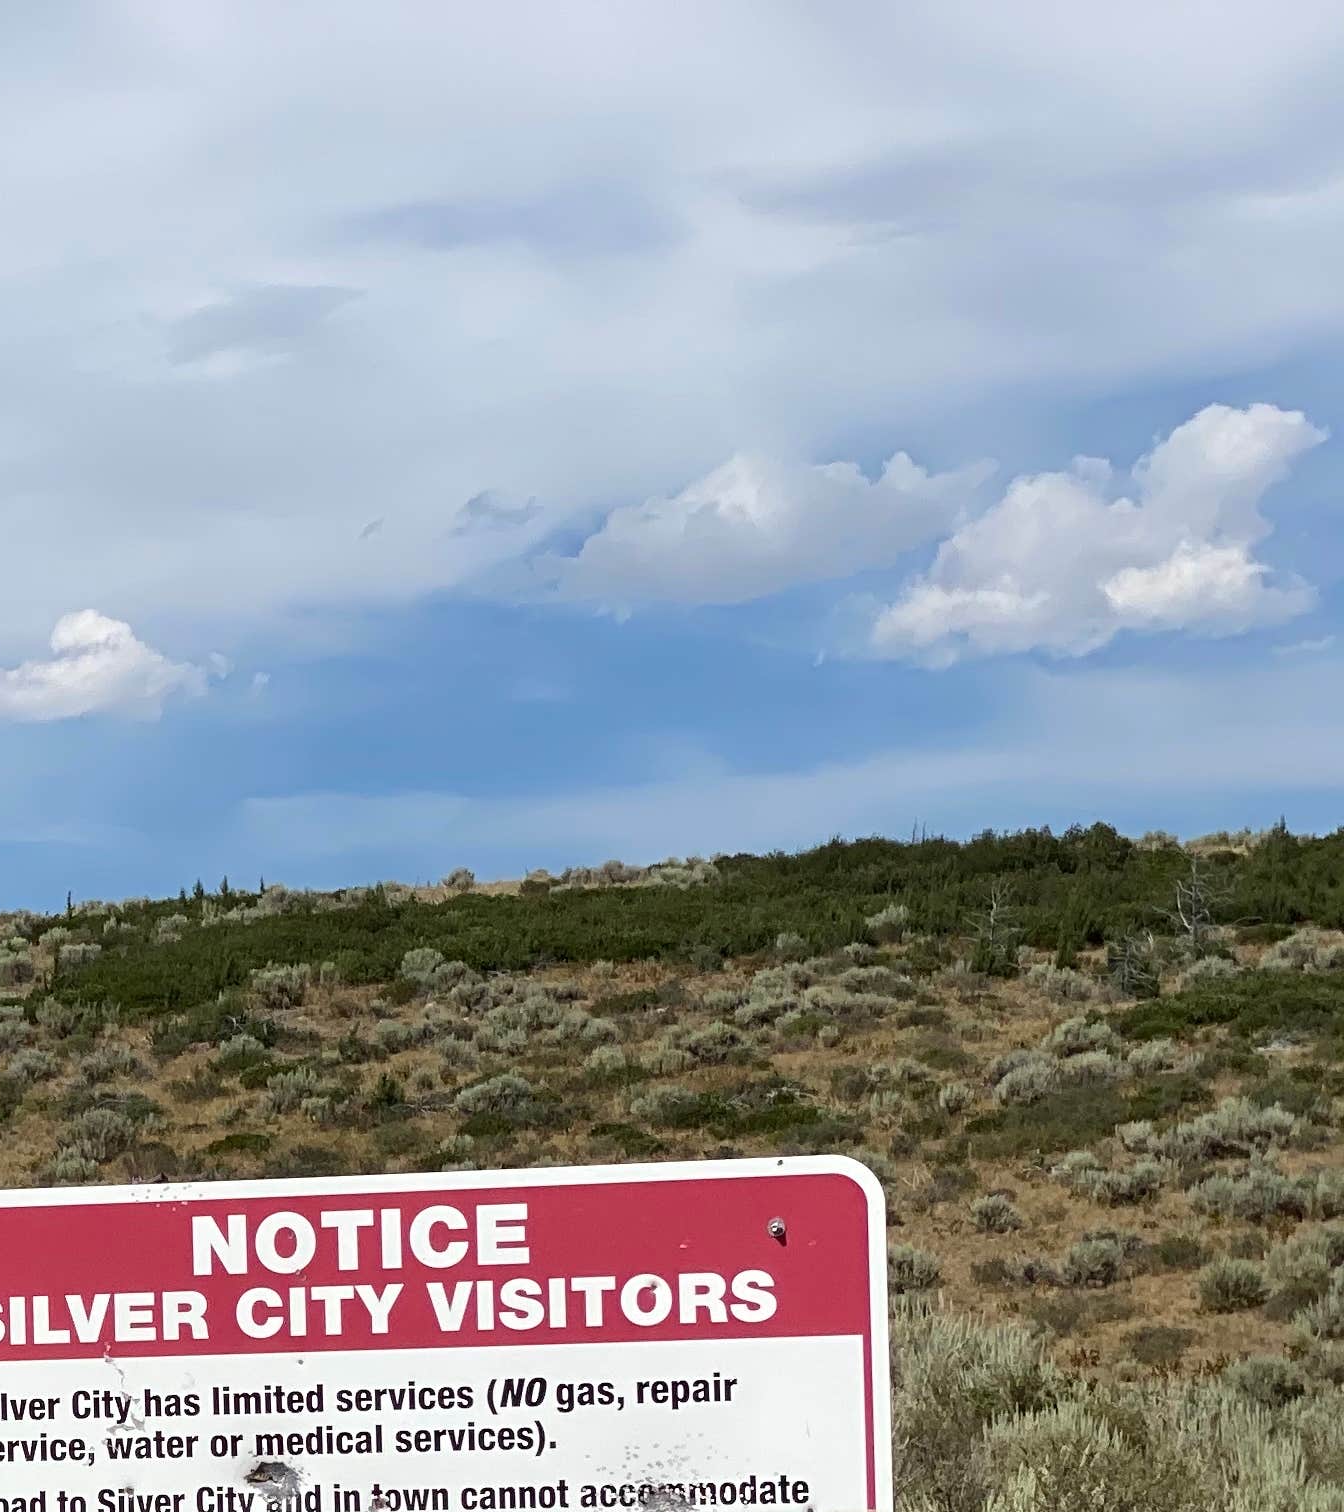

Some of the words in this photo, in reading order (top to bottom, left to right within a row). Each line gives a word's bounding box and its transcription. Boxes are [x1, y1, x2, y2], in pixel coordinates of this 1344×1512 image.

[191, 1203, 530, 1276] NOTICE
[235, 1283, 405, 1339] CITY
[425, 1269, 778, 1332] VISITORS
[72, 1389, 132, 1425] City
[144, 1388, 201, 1417] has
[212, 1383, 324, 1415] limited
[336, 1381, 474, 1412] services
[486, 1377, 547, 1416] (NO
[556, 1382, 625, 1413] gas,
[636, 1372, 738, 1410] repair
[106, 1430, 199, 1460] water
[210, 1434, 244, 1458] or
[253, 1424, 383, 1458] medical
[395, 1420, 557, 1457] services).
[333, 1483, 361, 1512] in
[371, 1483, 449, 1512] town
[461, 1479, 569, 1511] cannot
